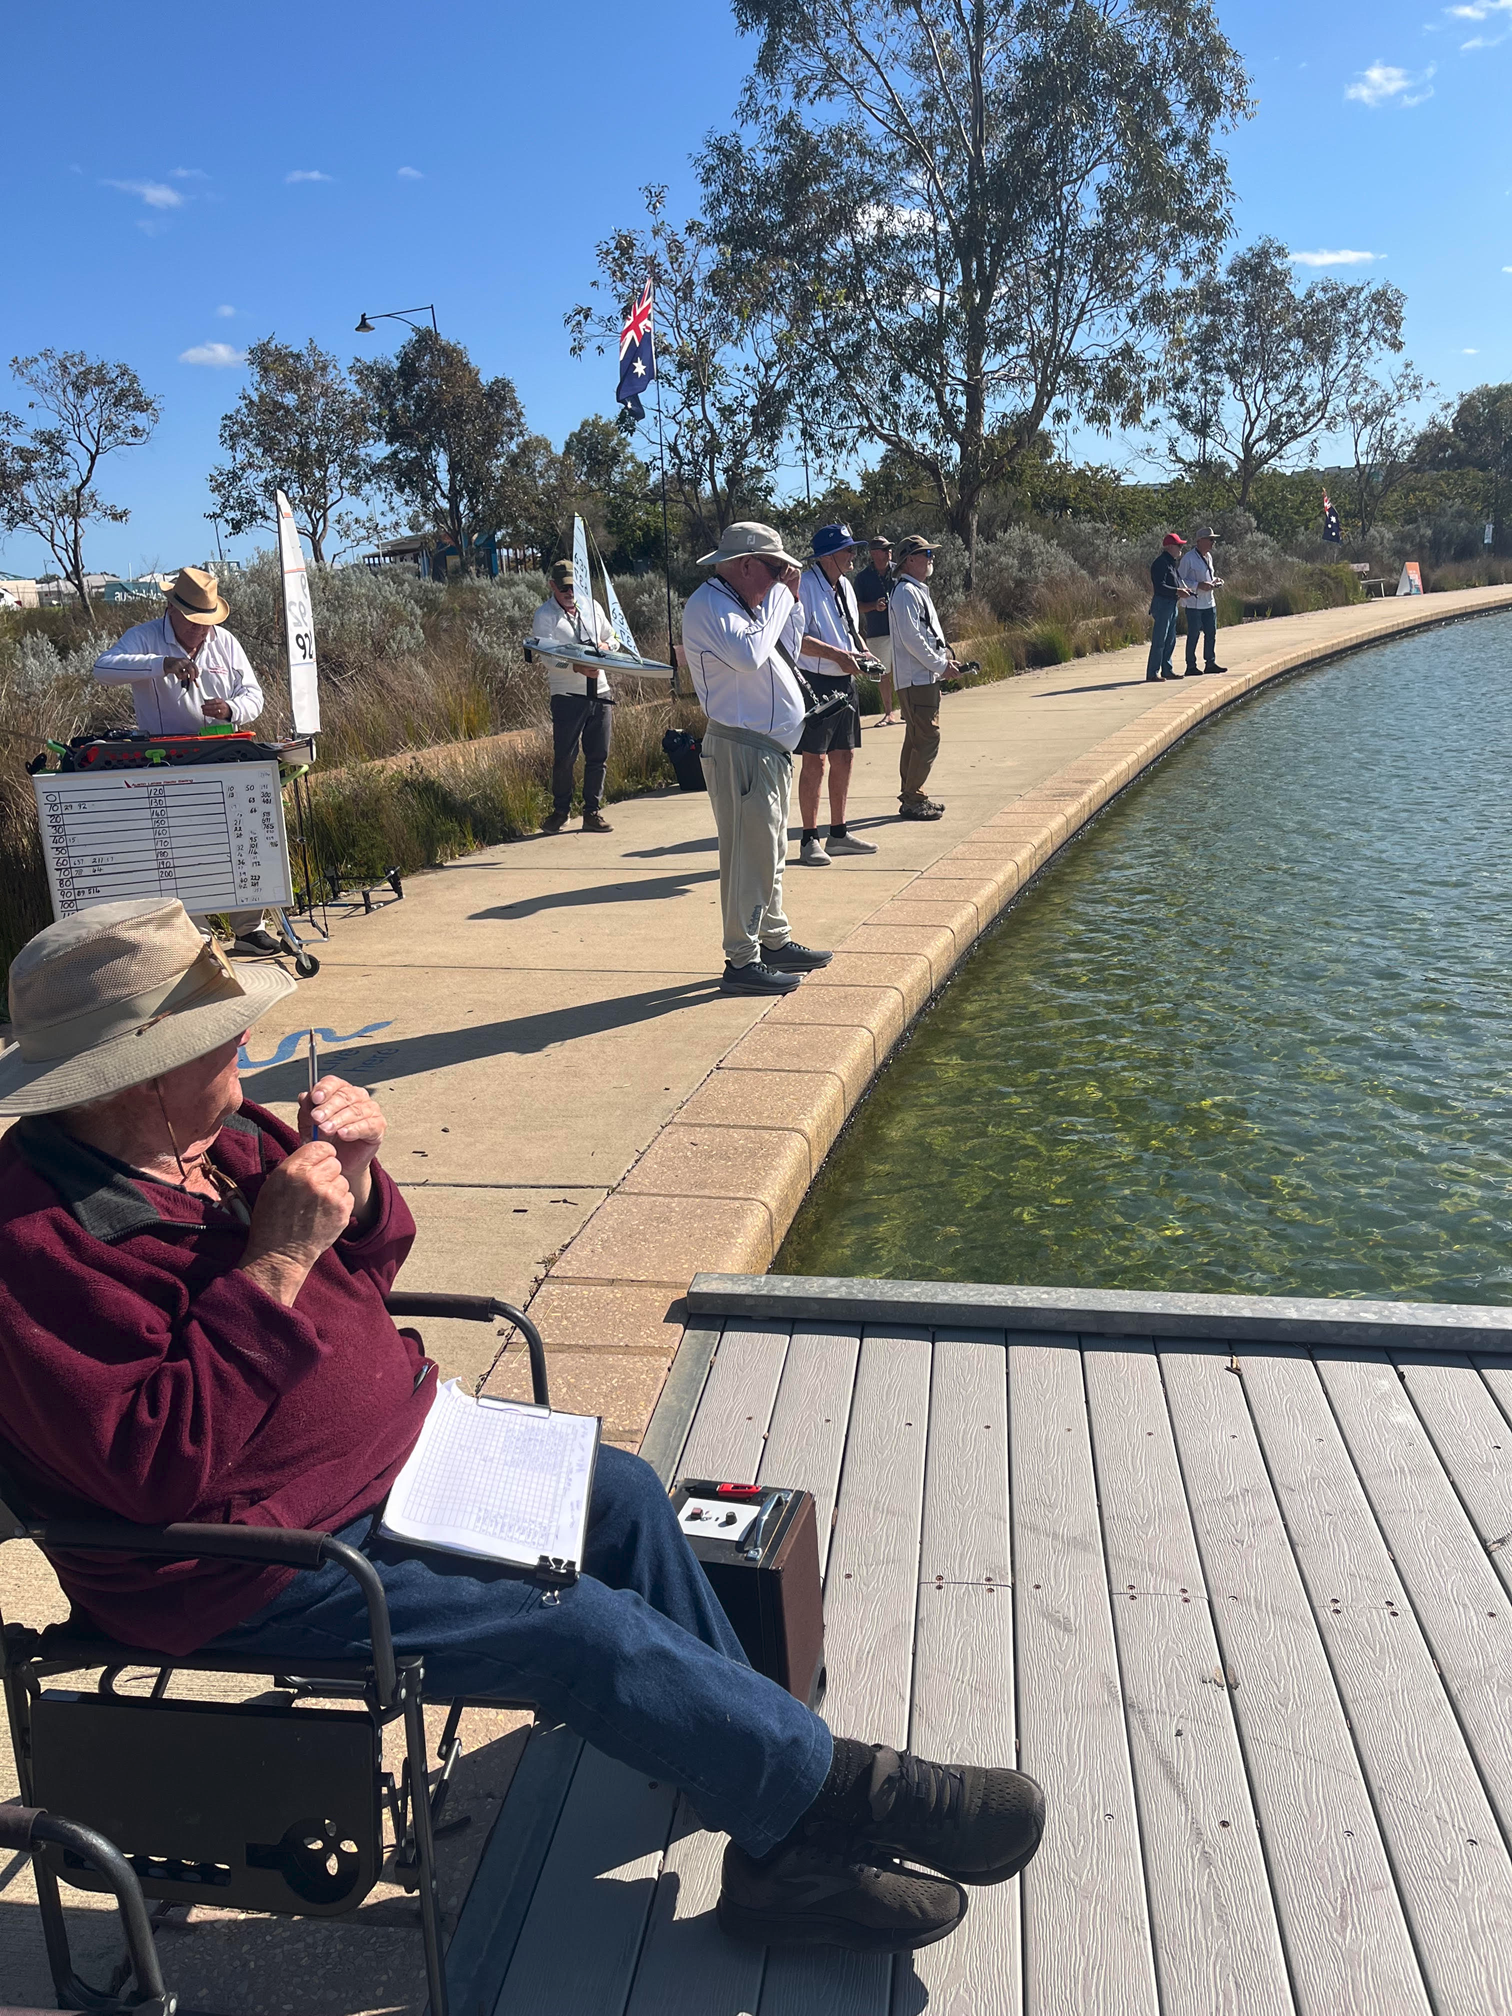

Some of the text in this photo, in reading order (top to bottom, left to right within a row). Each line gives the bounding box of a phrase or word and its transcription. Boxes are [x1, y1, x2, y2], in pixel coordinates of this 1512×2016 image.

[746, 535, 756, 545] FJ
[50, 815, 61, 823] 20
[51, 826, 63, 834] 30
[52, 836, 64, 844] 40
[54, 847, 67, 855] 50
[56, 858, 68, 866] 60
[59, 880, 71, 888] 80
[60, 890, 72, 899] 90
[60, 901, 74, 909] 100
[343, 1048, 399, 1072] here
